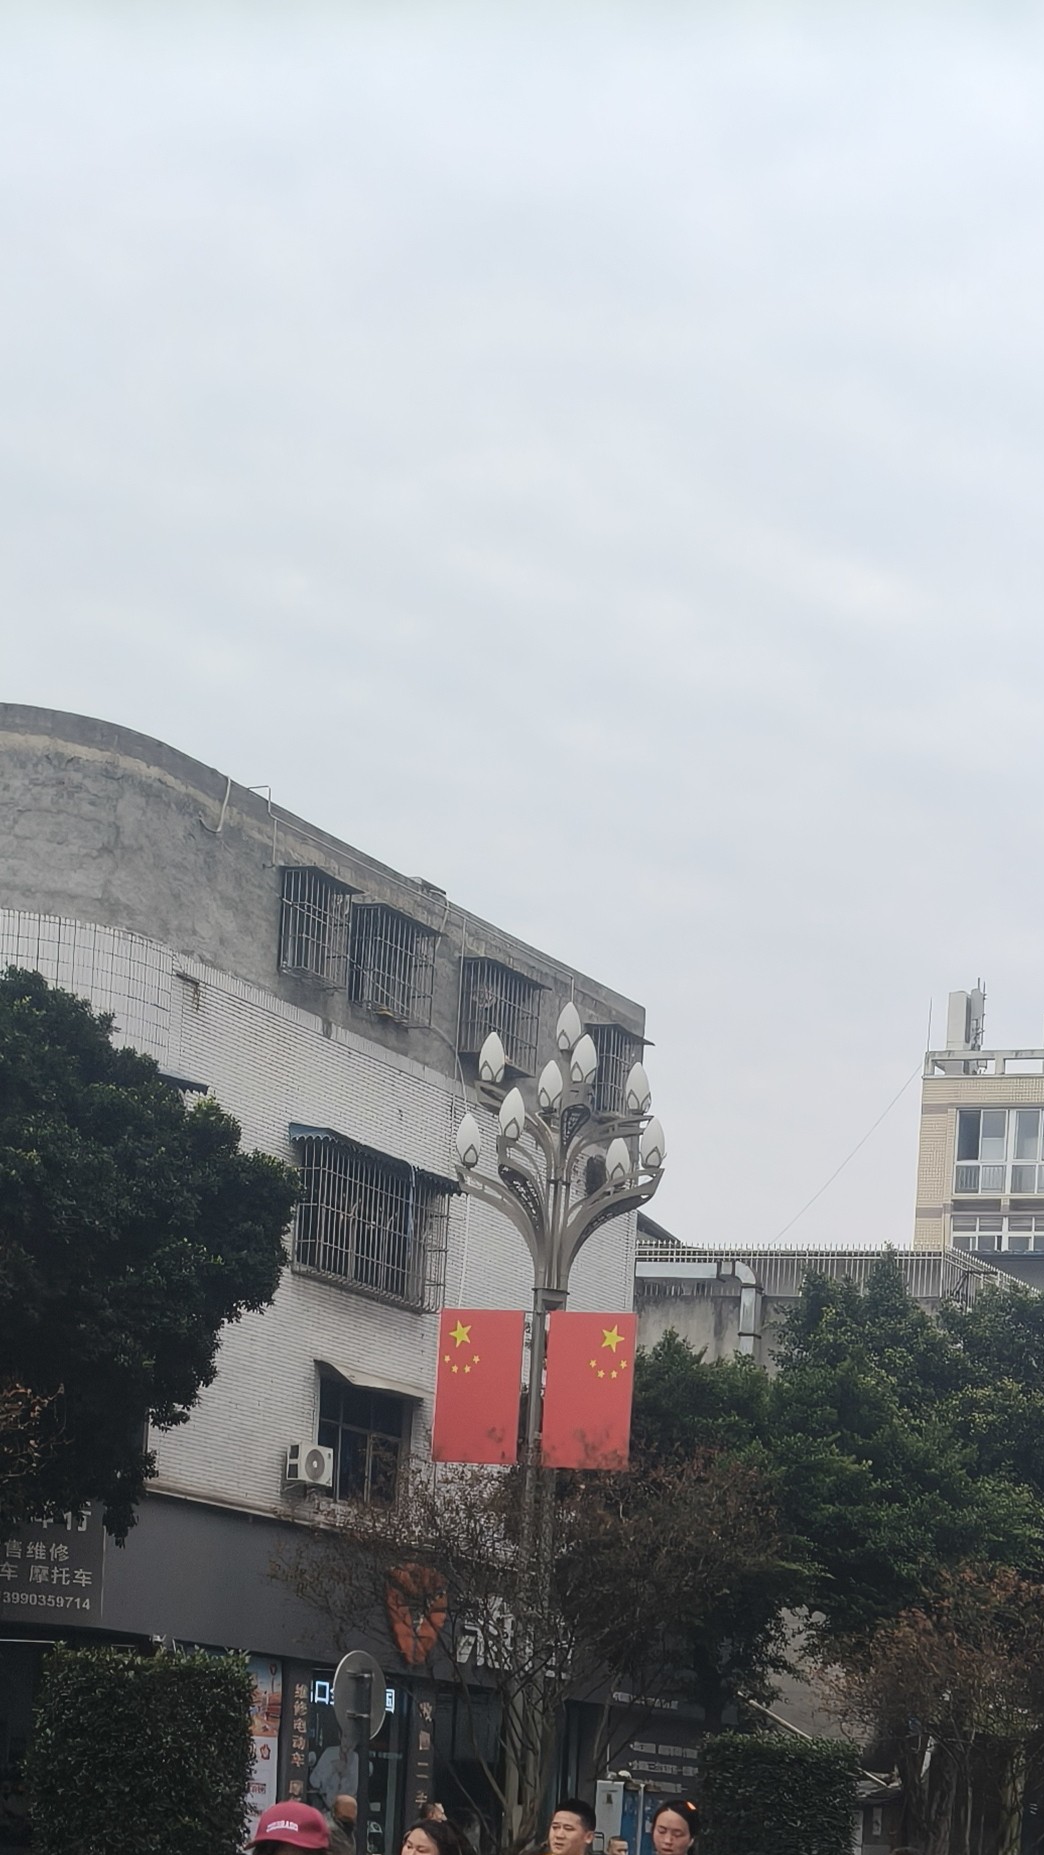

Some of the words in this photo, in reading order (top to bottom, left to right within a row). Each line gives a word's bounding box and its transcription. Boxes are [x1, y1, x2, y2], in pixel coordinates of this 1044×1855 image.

[4, 1539, 70, 1562] 售维修
[29, 1565, 92, 1587] 摩托车
